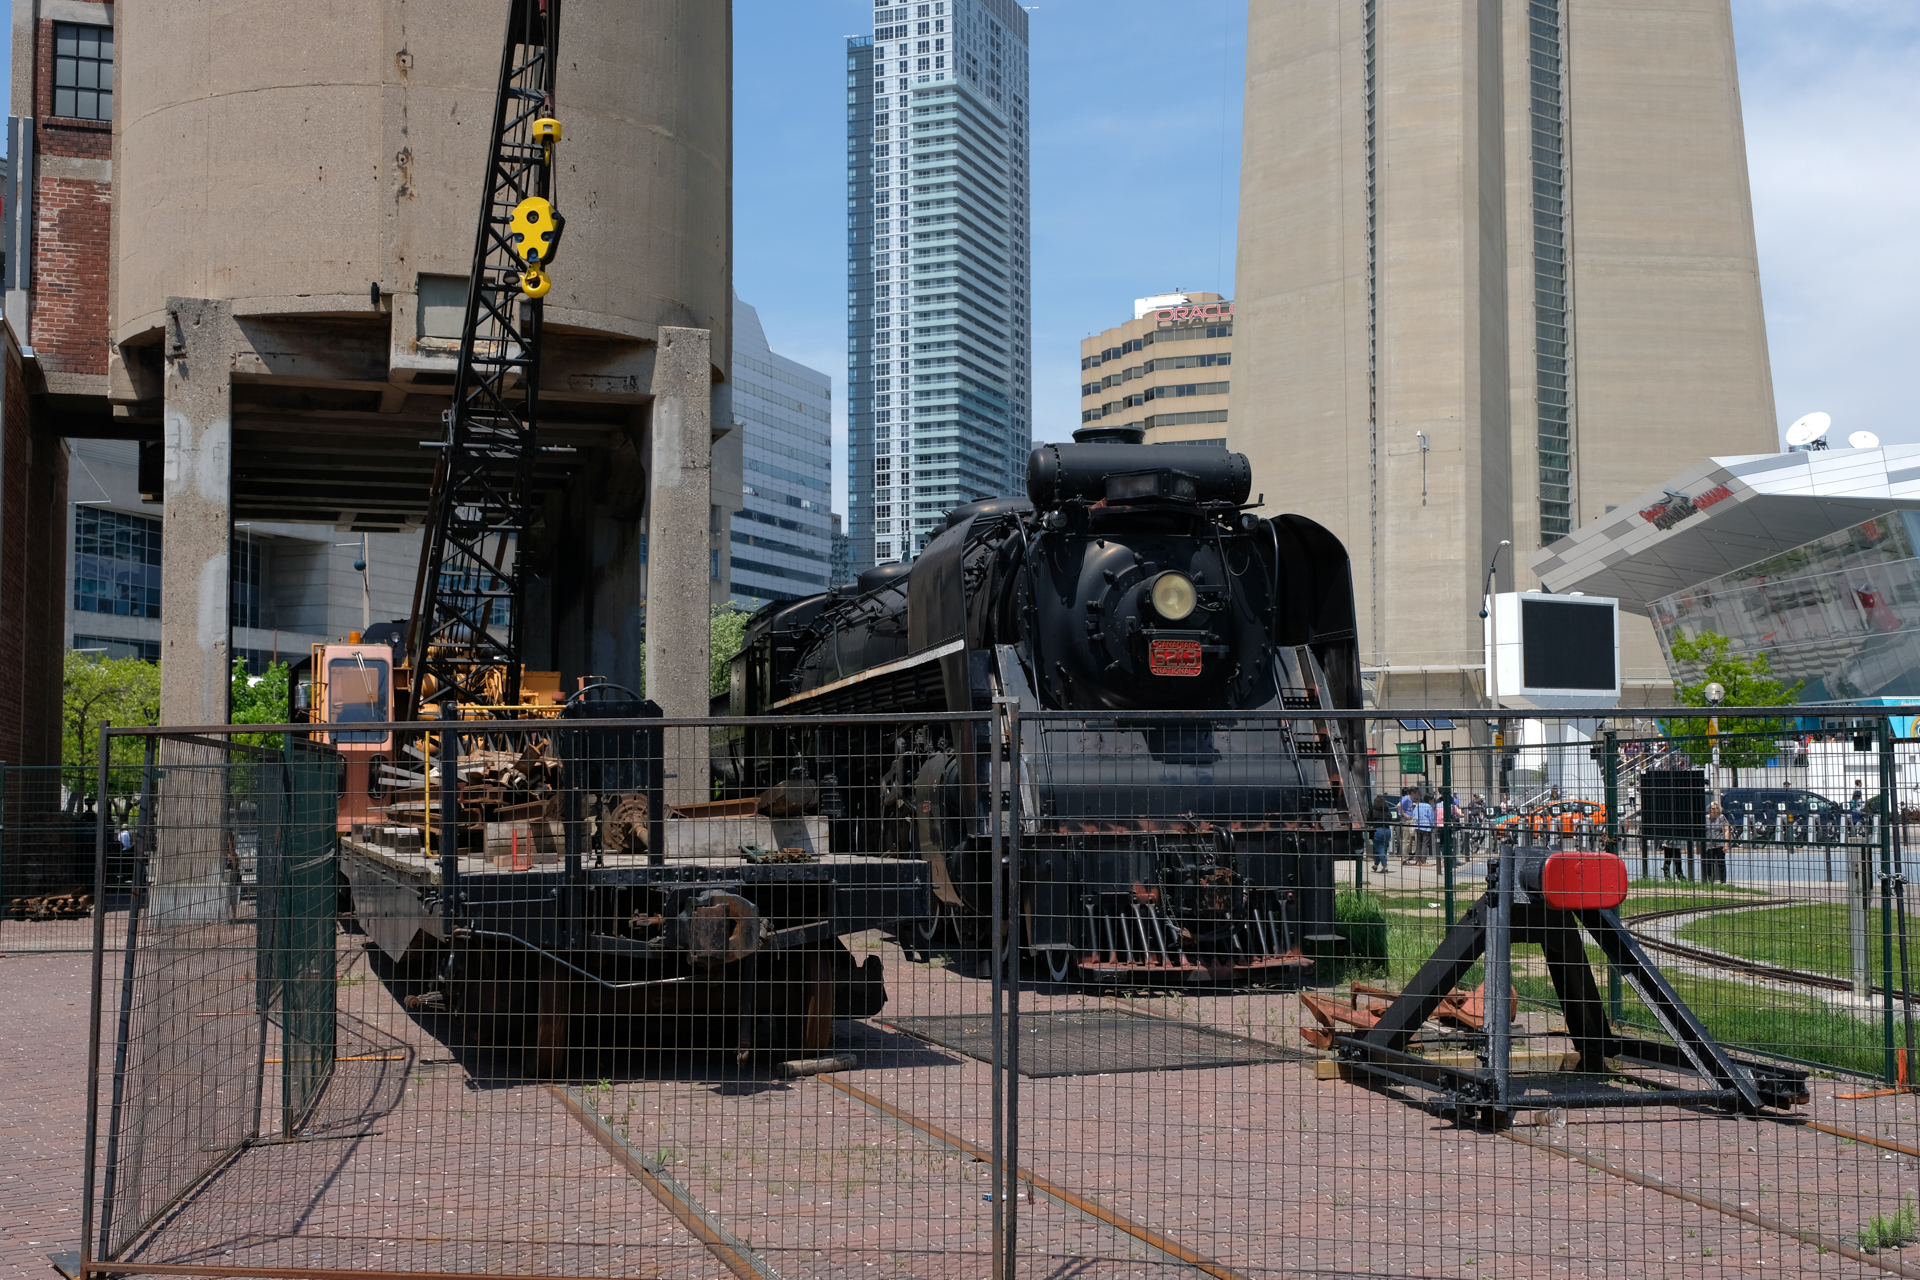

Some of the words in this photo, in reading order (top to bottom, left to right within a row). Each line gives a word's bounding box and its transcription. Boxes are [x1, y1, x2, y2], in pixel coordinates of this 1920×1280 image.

[1692, 484, 1735, 511] CANADA
[1157, 641, 1194, 649] CANADIAN
[1154, 649, 1197, 667] 6213
[1156, 667, 1195, 675] NATIONAL
